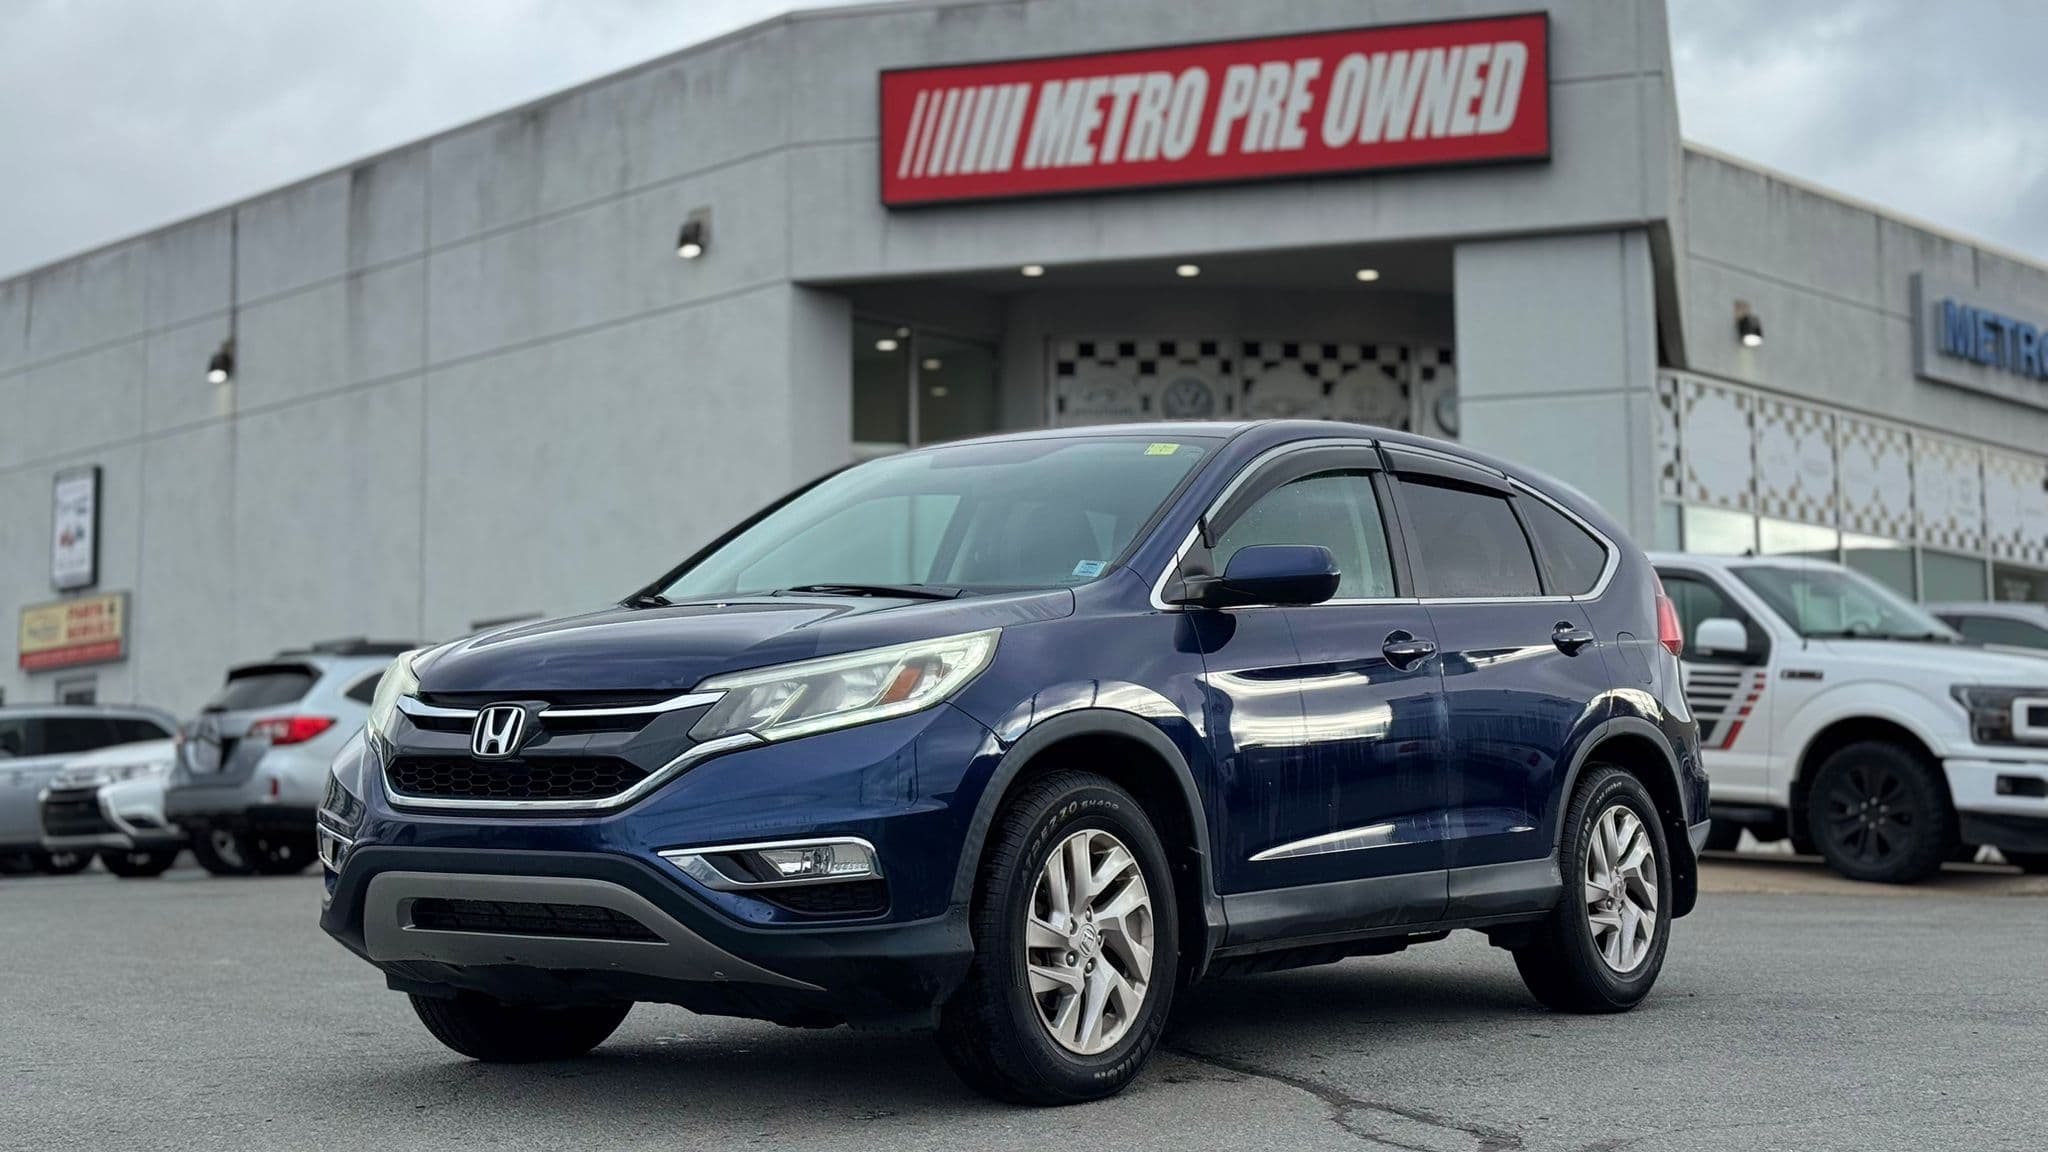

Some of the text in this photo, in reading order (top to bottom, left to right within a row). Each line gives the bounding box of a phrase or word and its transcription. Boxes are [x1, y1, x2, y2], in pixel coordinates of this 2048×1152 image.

[1022, 40, 1529, 170] METRO PRE OWNED
